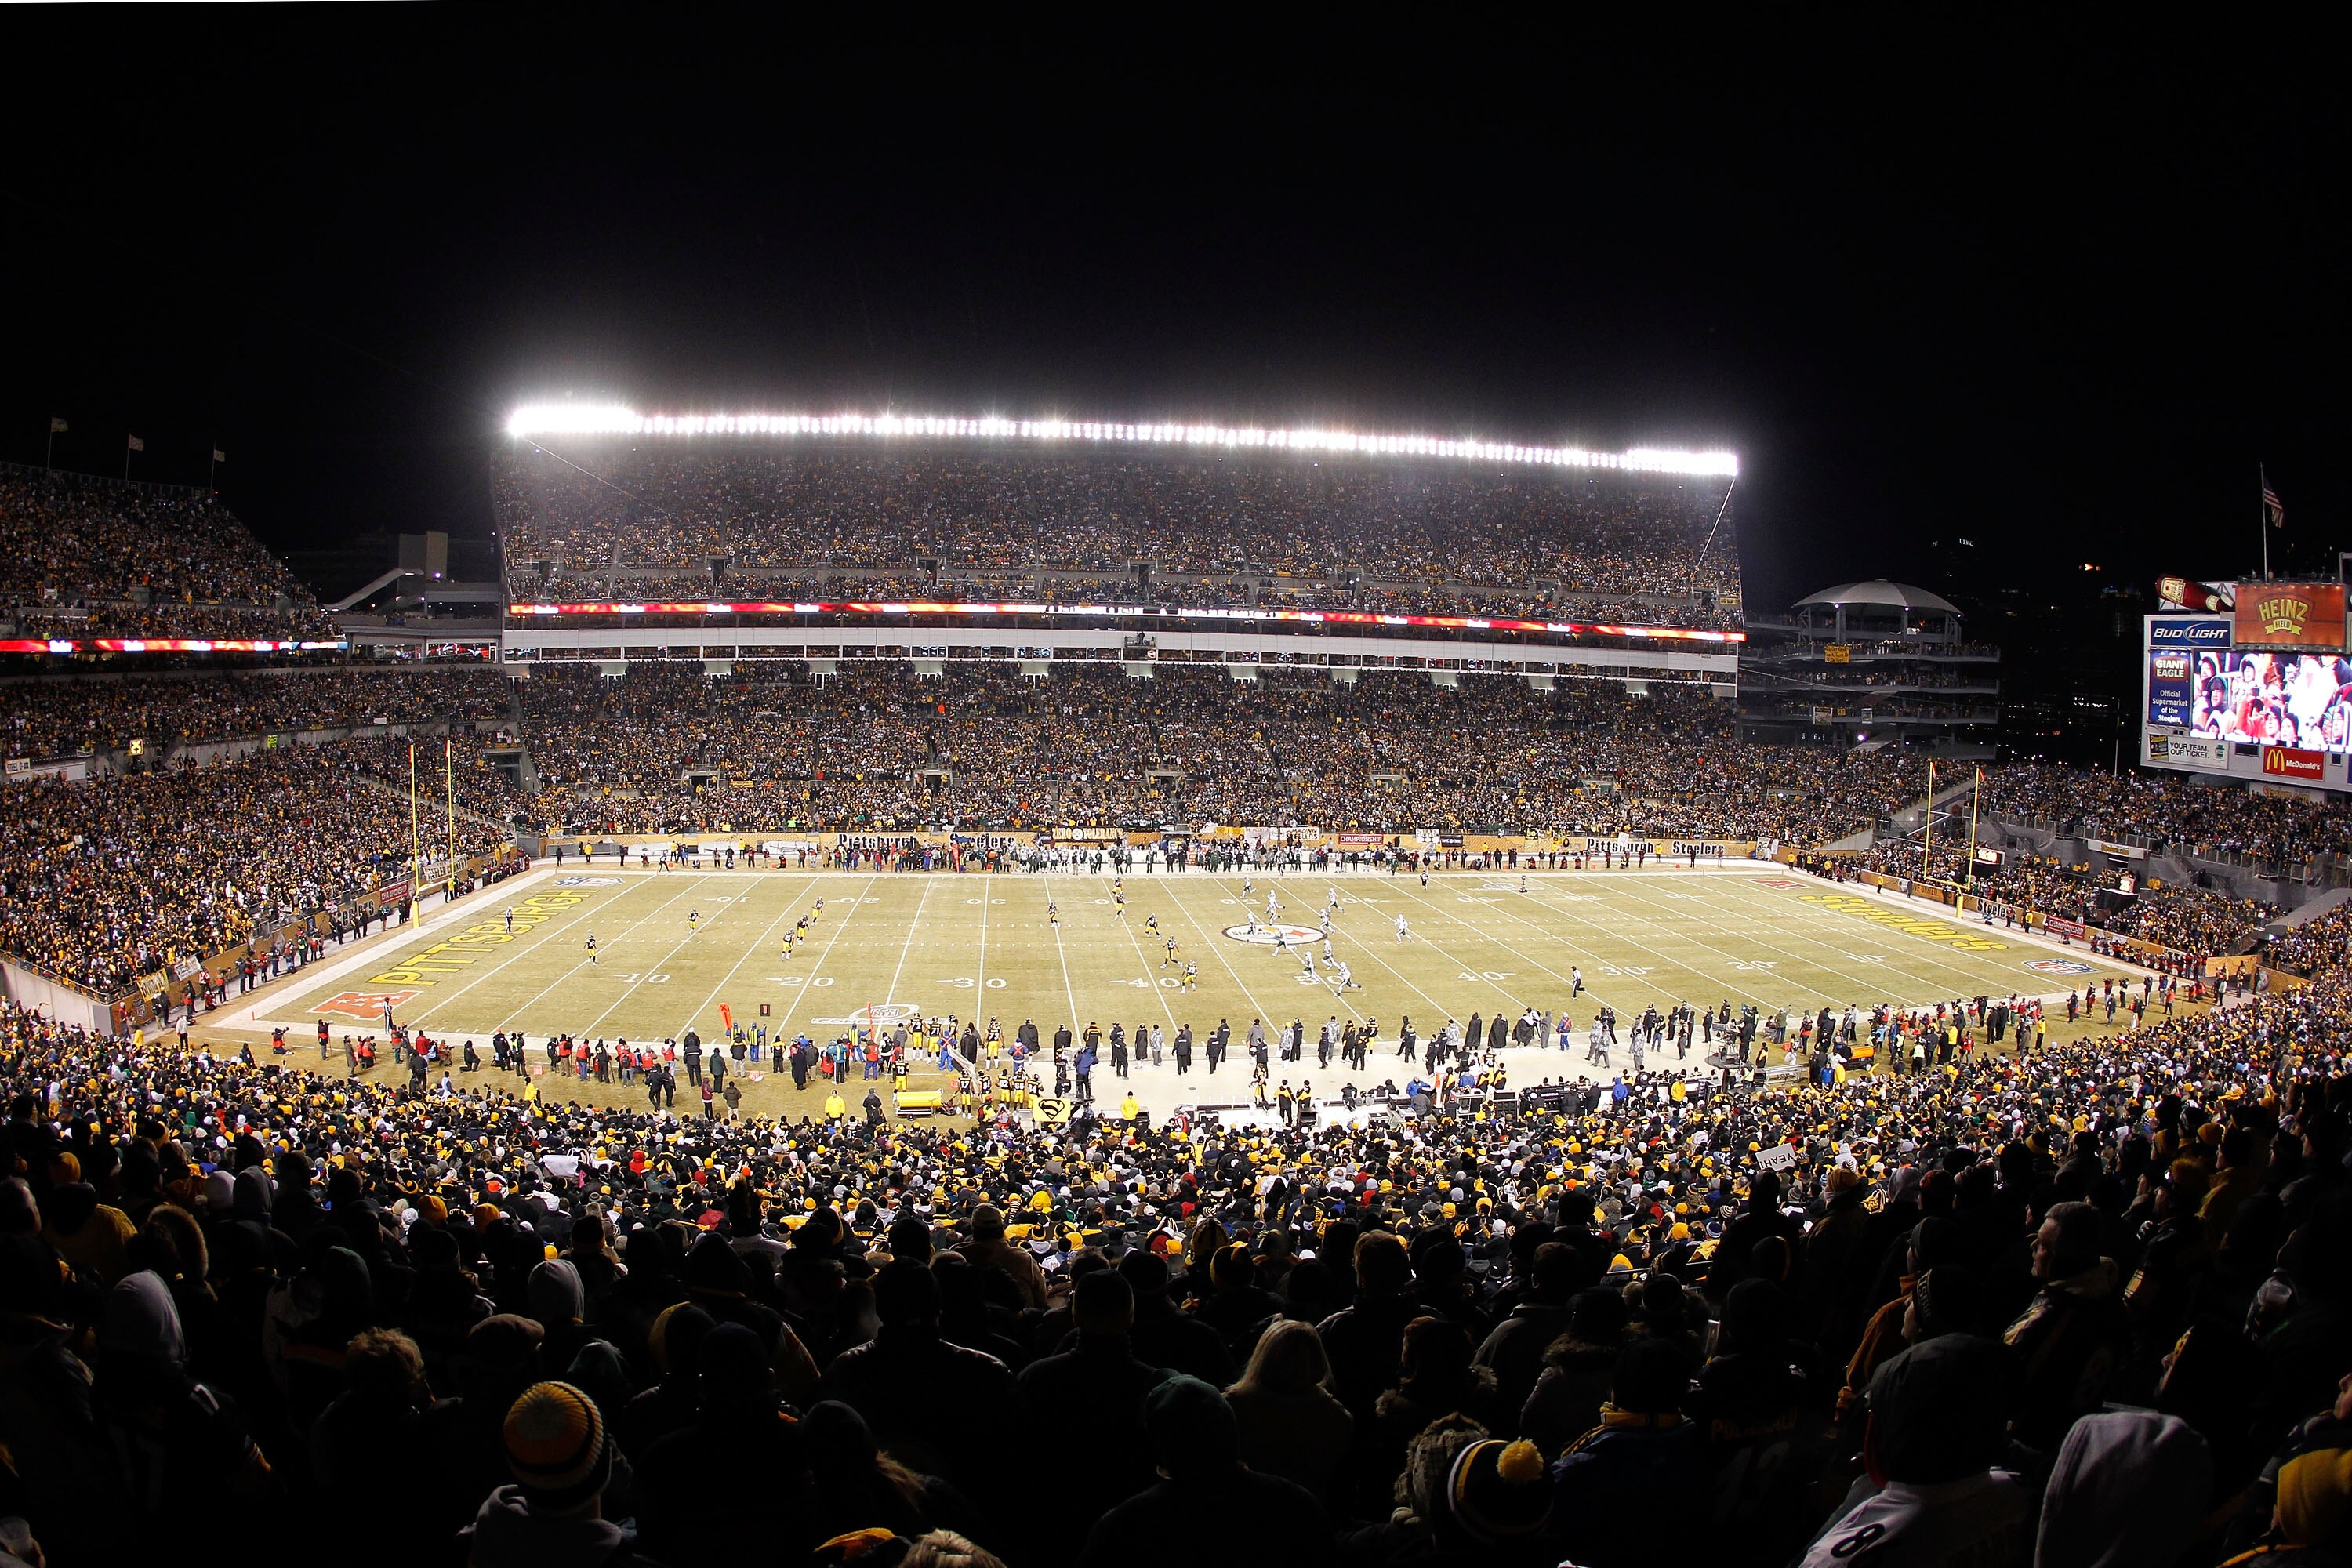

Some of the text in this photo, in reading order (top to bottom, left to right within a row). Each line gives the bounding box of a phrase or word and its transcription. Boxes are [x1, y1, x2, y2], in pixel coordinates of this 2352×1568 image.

[2259, 598, 2308, 622] HEINZ
[2275, 619, 2291, 629] FIELD
[2153, 627, 2228, 639] BUD LIGHT
[2155, 659, 2186, 670] GIANT
[2156, 669, 2184, 678] EAGLE
[2160, 689, 2180, 698] Official
[2152, 697, 2188, 707] Supermarket
[2170, 742, 2209, 752] YOUR TEAM.
[2186, 750, 2210, 759] TICKET.
[2285, 759, 2321, 771] McDonald's
[1051, 827, 1072, 840] ZERO
[1796, 893, 2009, 951] Steelers
[365, 889, 601, 985] PITTSBURGH
[1759, 1152, 1795, 1169] YEAH!
